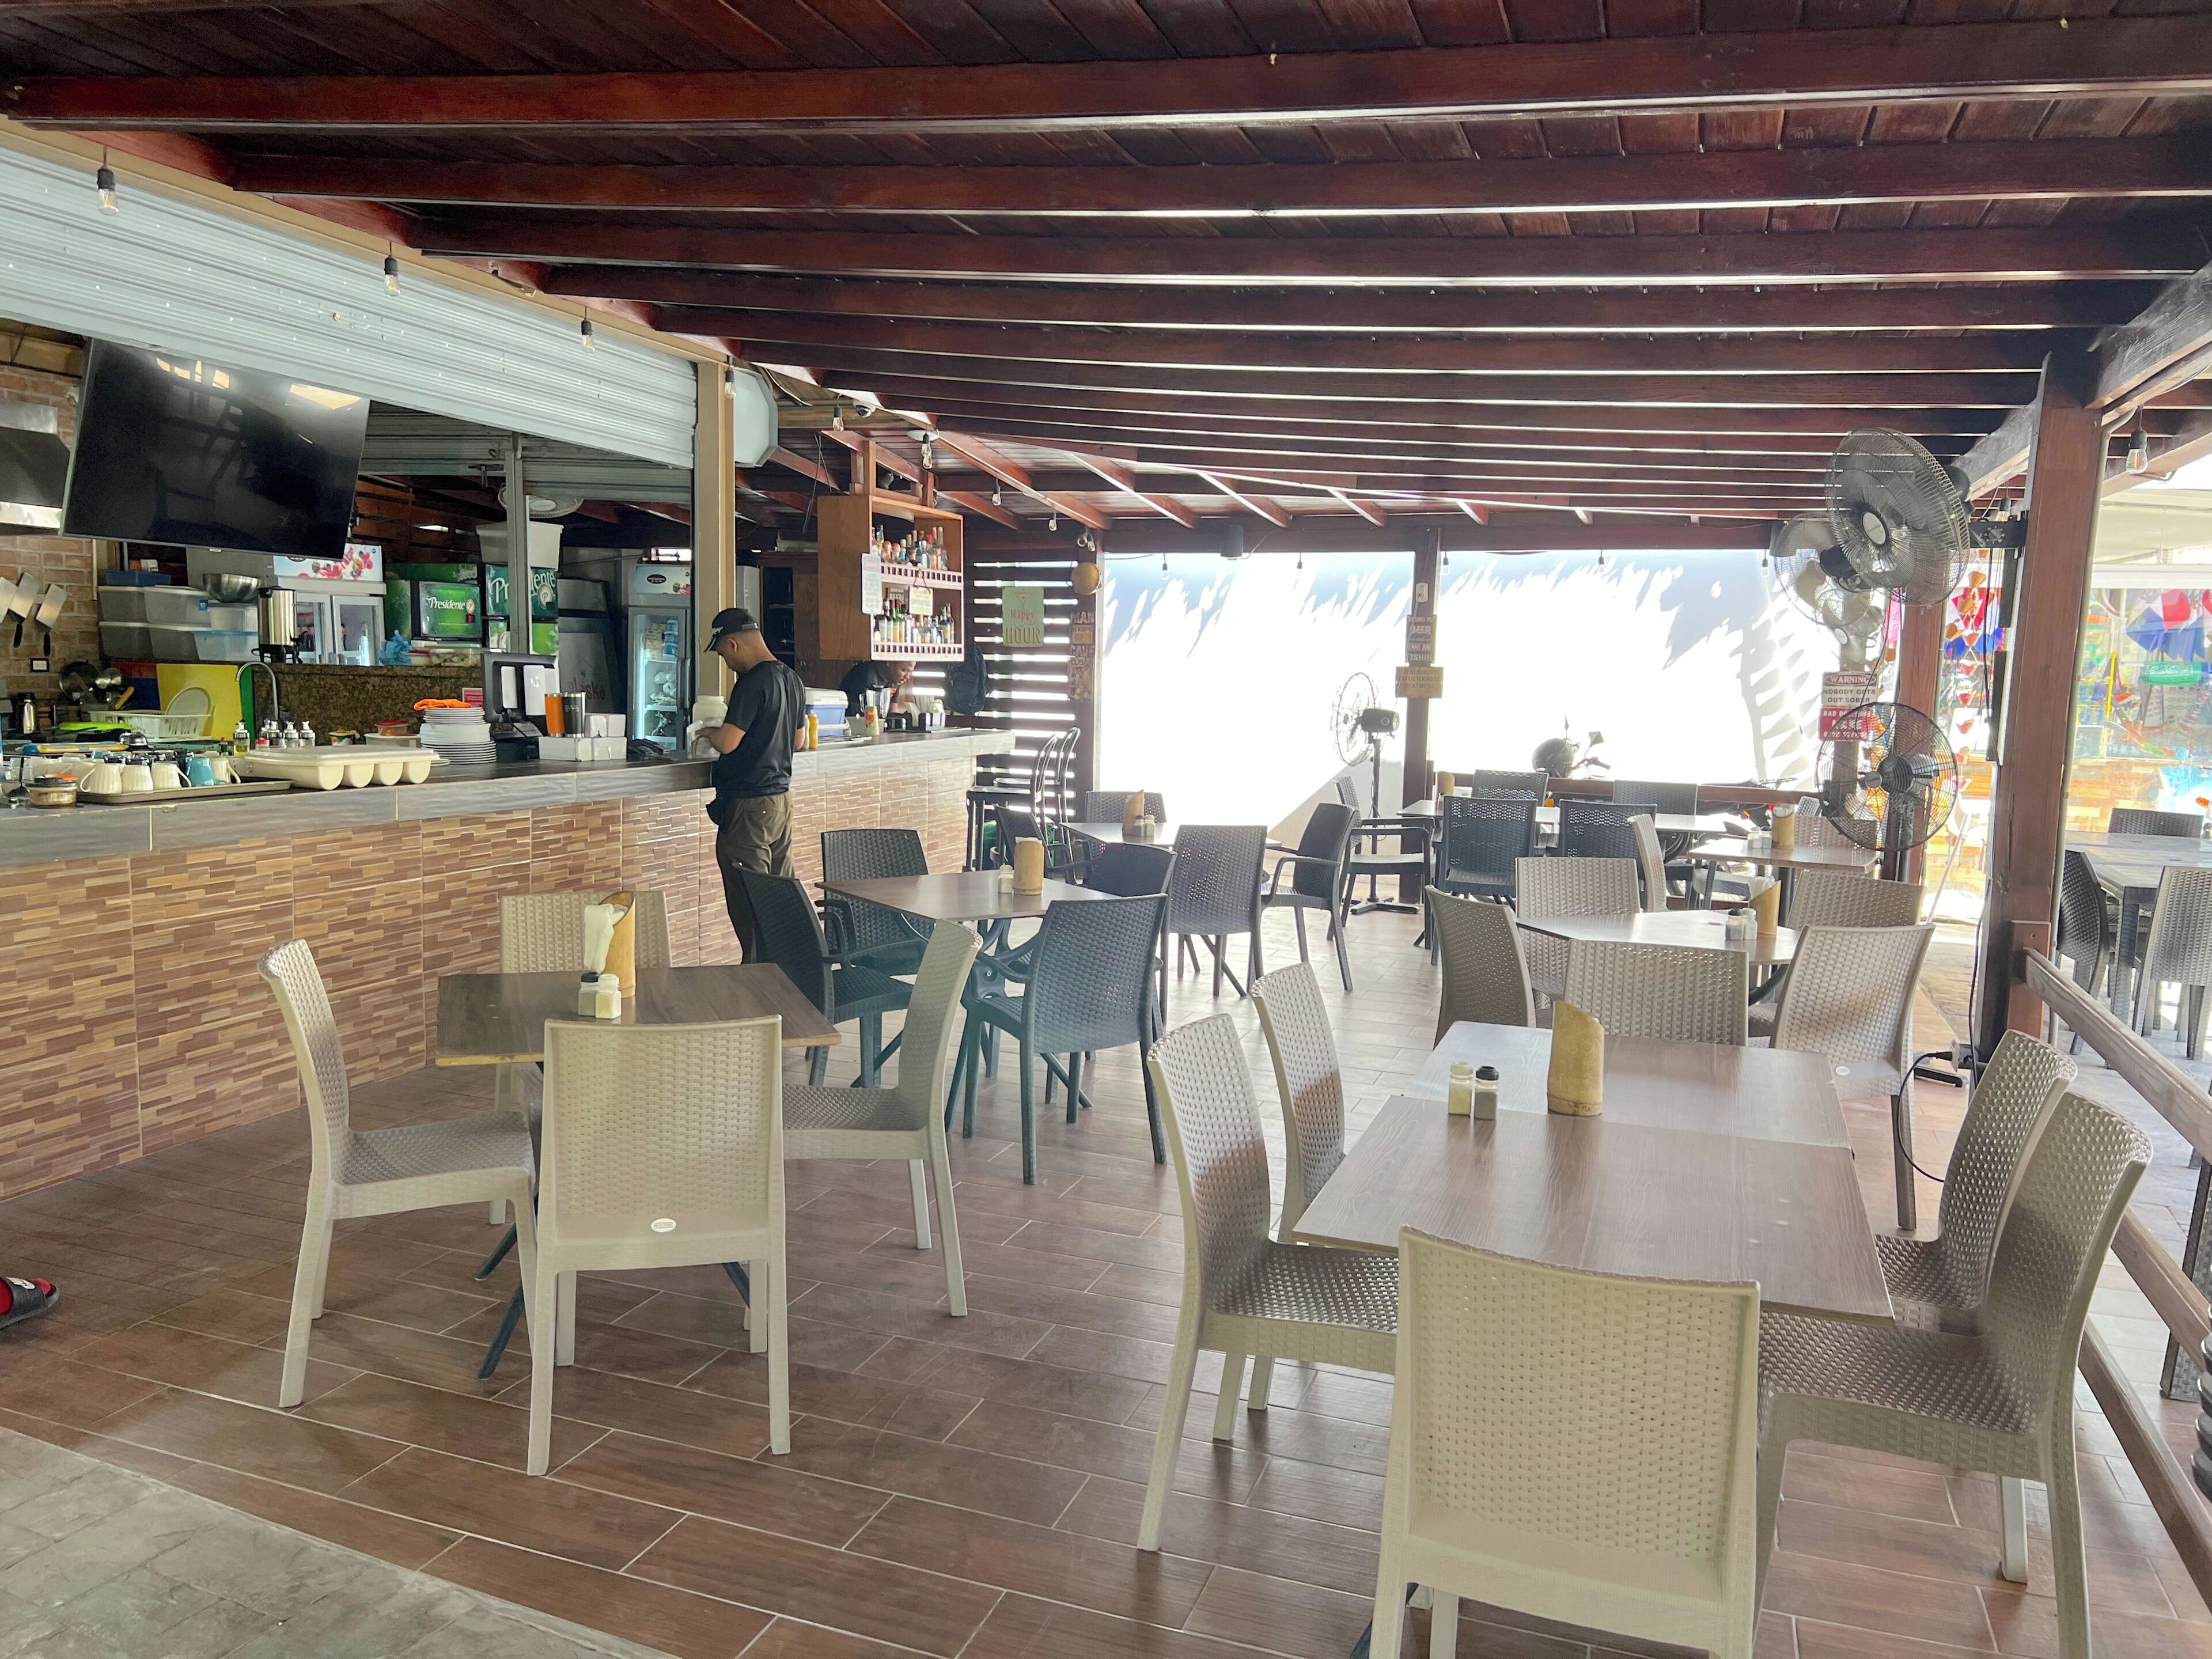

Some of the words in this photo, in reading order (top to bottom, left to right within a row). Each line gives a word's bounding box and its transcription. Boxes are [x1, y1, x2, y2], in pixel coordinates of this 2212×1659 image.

[427, 597, 465, 609] Presidente
[1010, 609, 1034, 623] Happy
[1006, 626, 1041, 644] HOUR
[1411, 626, 1431, 635] BEER
[1831, 675, 1870, 684] WARNING
